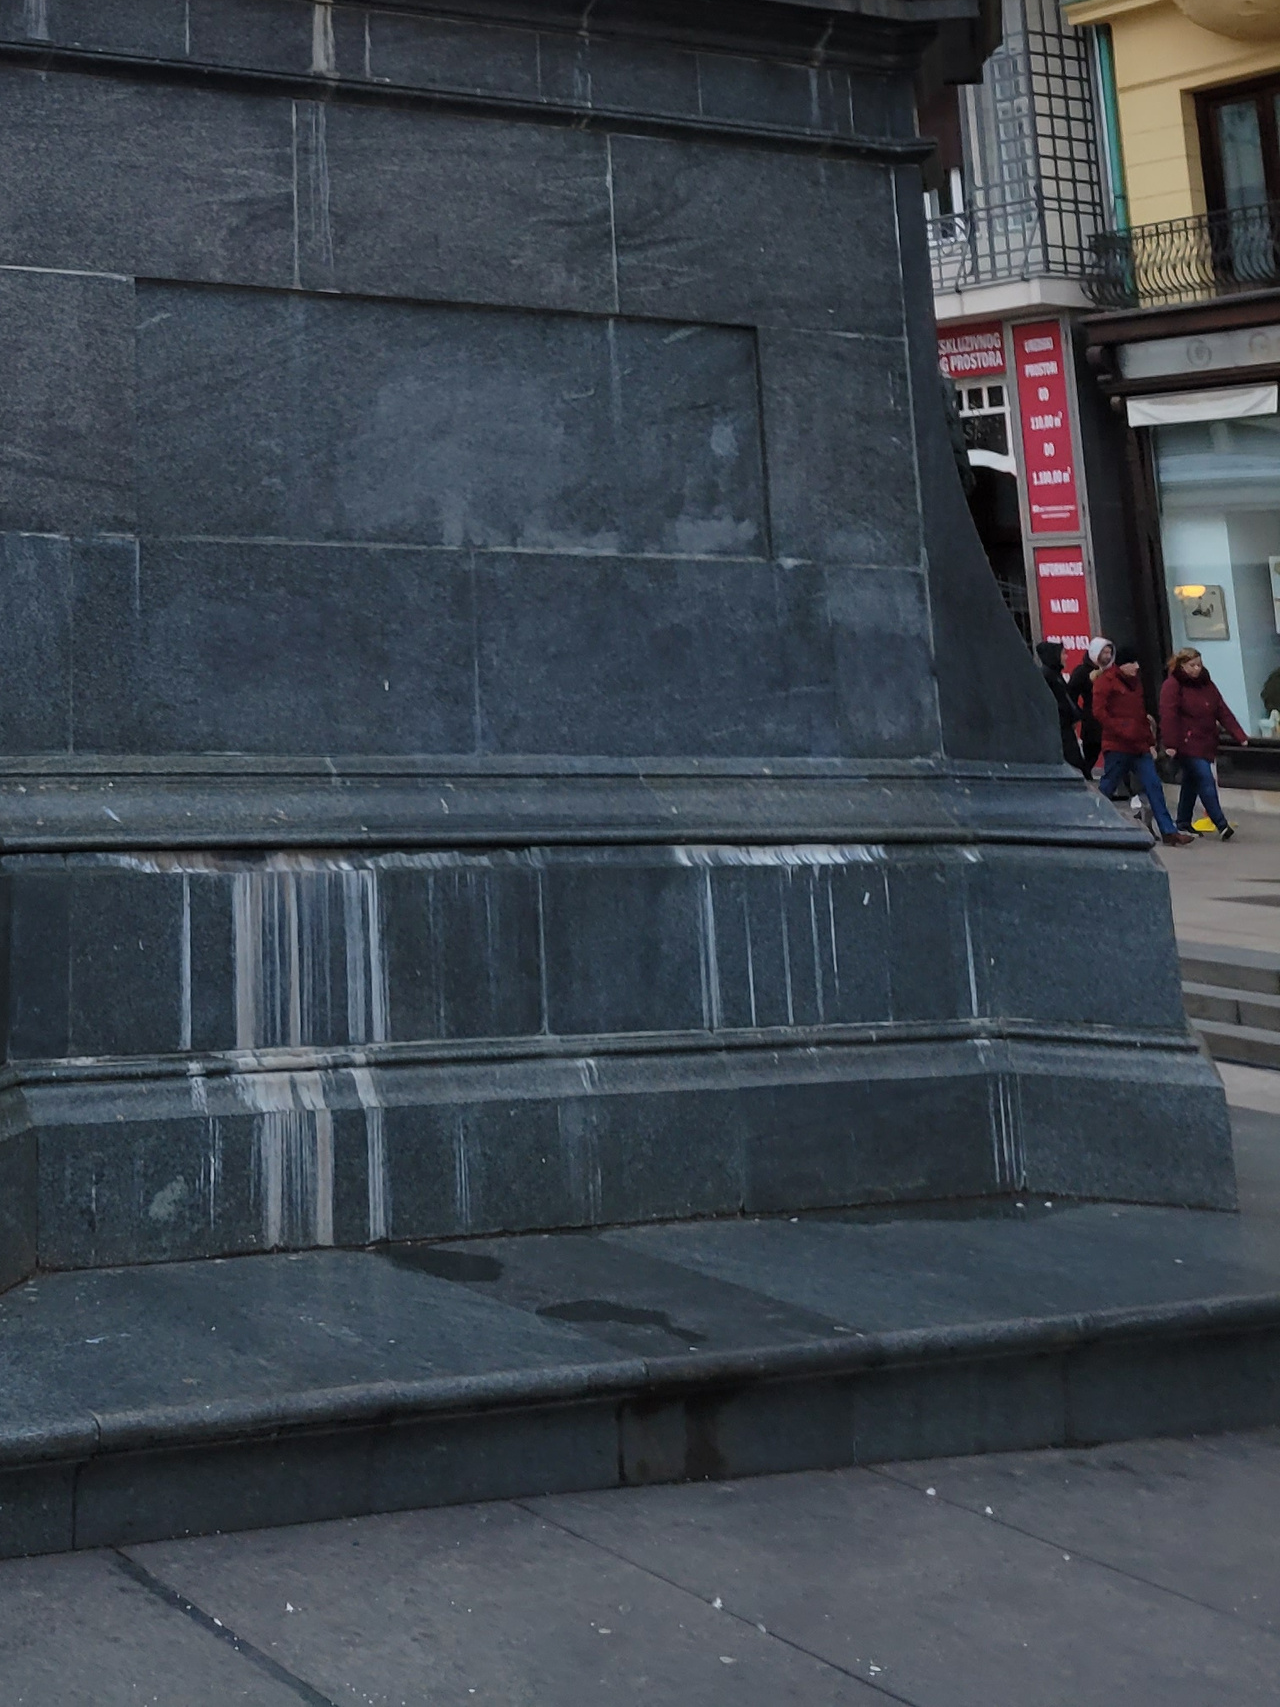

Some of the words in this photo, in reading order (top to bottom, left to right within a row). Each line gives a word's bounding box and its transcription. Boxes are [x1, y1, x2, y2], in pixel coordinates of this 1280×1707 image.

[937, 332, 1002, 355] SKLUZIVNOG
[939, 356, 950, 373] G
[949, 350, 1004, 372] PROSTORA
[1050, 598, 1061, 613] NA
[1061, 598, 1079, 613] BROJ
